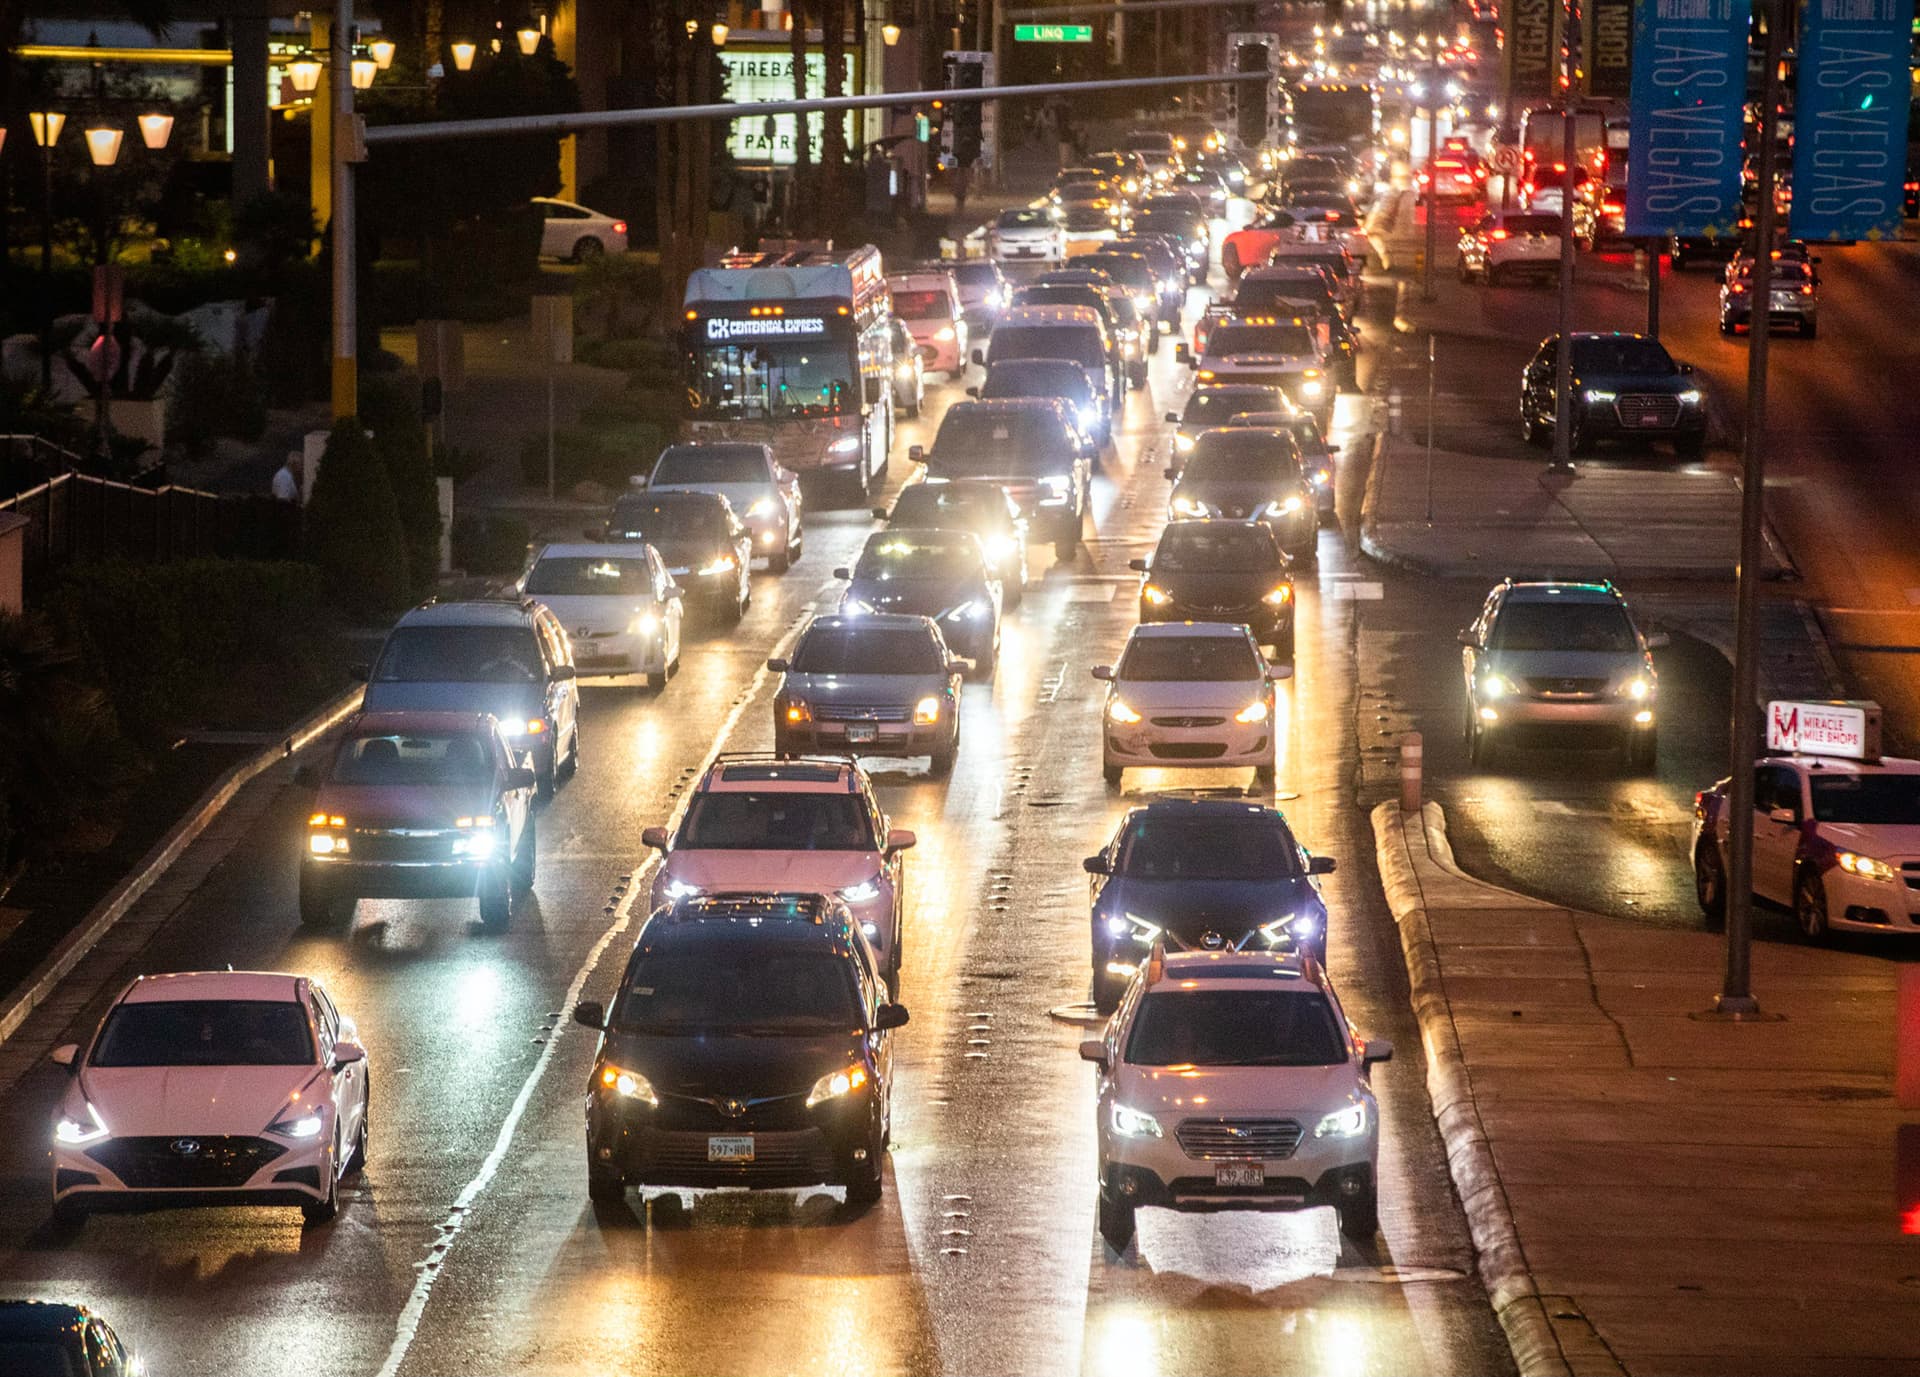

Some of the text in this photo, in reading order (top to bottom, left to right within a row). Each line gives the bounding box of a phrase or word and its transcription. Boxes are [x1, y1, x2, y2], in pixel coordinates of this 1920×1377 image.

[1033, 26, 1064, 41] LINQ
[1516, 0, 1547, 73] VEGAS
[1597, 5, 1628, 67] BORN
[1646, 28, 1729, 214] LAS VEGAS
[1810, 30, 1894, 216] LAS VEGAS
[707, 318, 824, 339] CX CENTENNIAL EXPRESS
[1803, 717, 1844, 732] MIRACLE
[1803, 730, 1858, 746] MILE SHOPS
